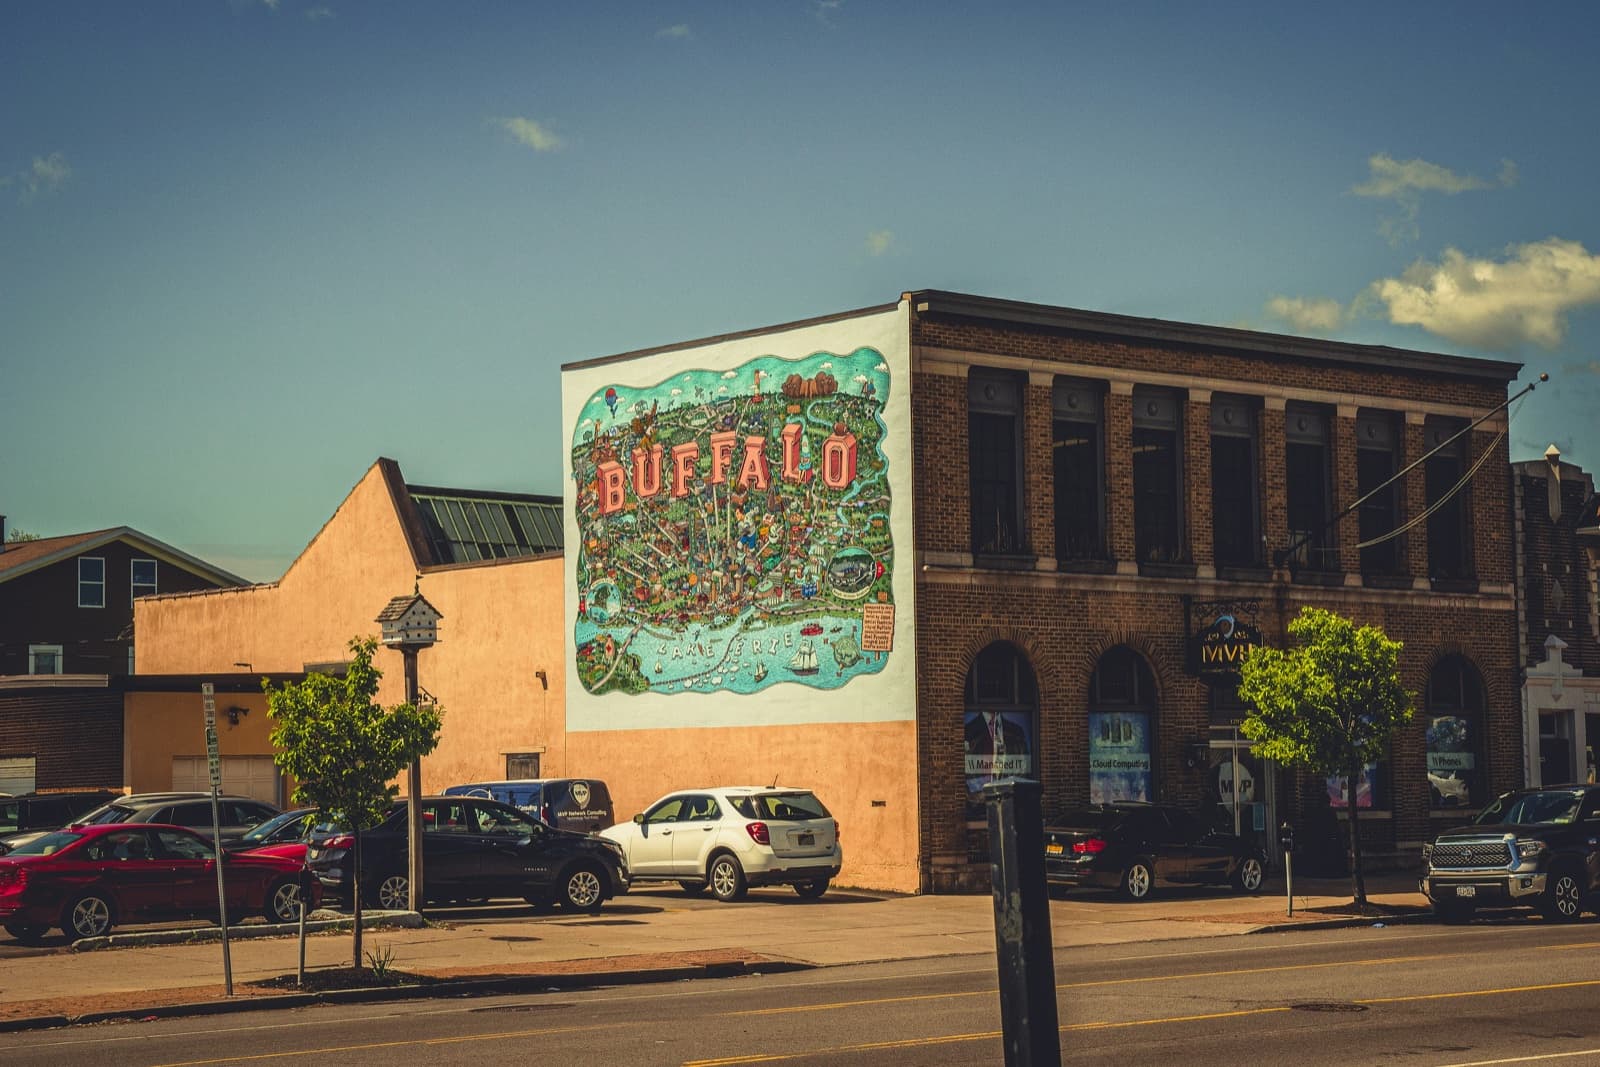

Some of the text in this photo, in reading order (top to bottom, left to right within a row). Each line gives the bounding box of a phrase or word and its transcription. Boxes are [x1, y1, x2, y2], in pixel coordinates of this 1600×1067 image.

[597, 422, 856, 515] BUFFALO
[657, 632, 795, 660] LAKE ERIE
[1093, 760, 1149, 770] Cloud Computing
